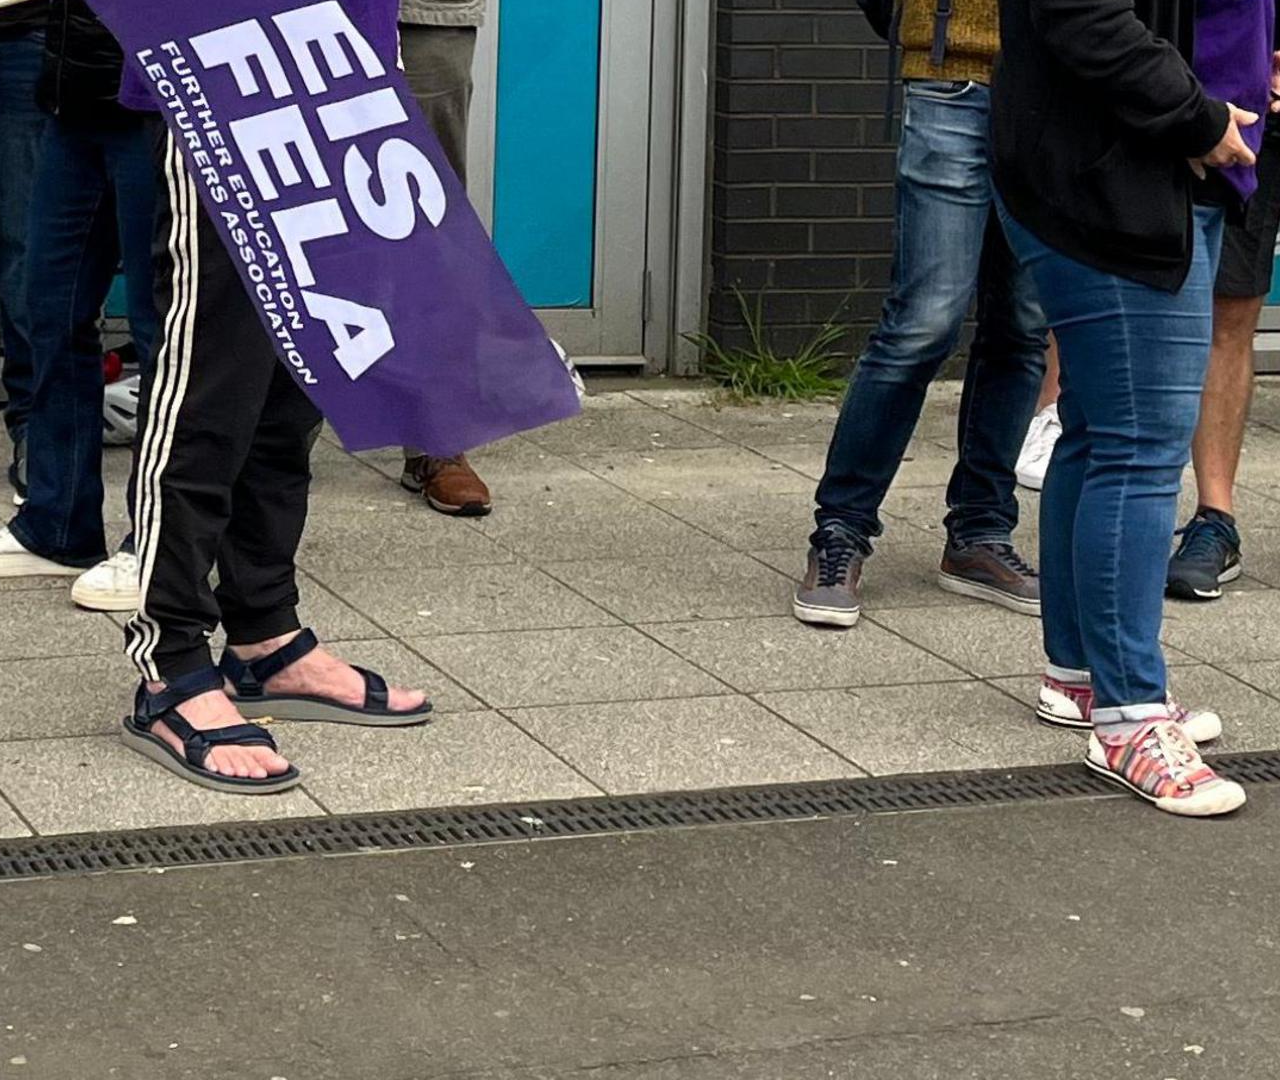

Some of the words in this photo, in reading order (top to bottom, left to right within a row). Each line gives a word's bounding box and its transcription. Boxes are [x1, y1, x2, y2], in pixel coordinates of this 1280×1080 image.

[136, 49, 229, 204] LECTURERS
[220, 210, 319, 387] ASSOCIATION
[160, 41, 234, 168] FURTHER
[227, 170, 305, 331] EDUCATION
[188, 19, 396, 381] FELA
[271, 0, 447, 241] EIS
